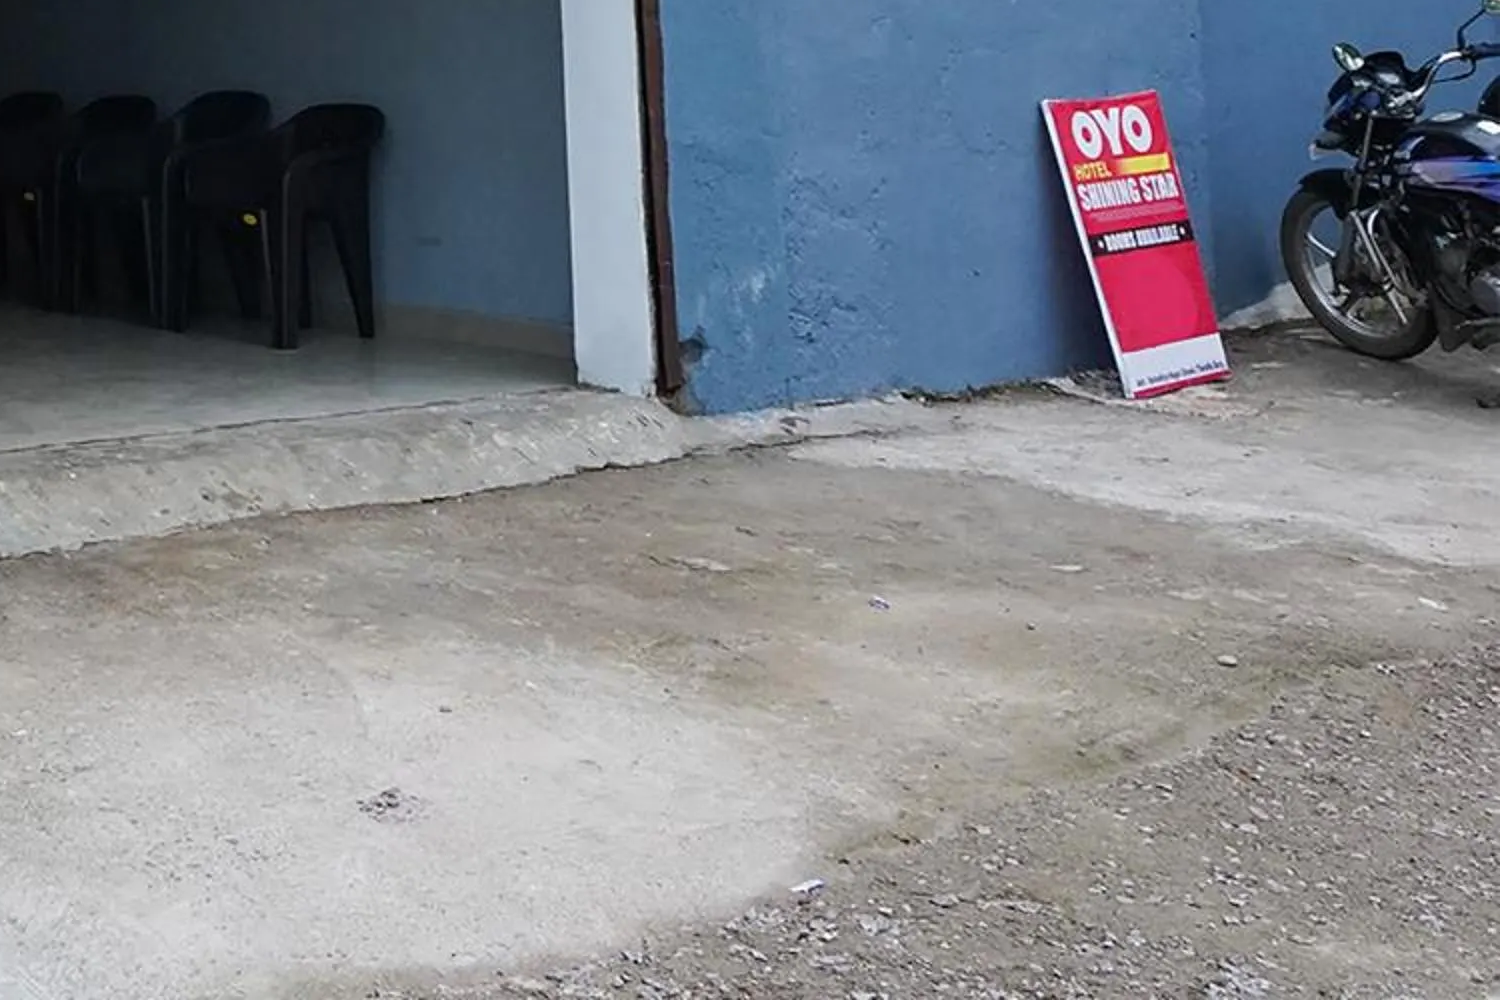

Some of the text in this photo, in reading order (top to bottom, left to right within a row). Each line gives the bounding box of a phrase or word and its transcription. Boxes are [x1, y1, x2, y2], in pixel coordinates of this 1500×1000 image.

[1071, 104, 1153, 160] OYO
[1073, 161, 1112, 181] HOTEL
[1077, 173, 1179, 211] SHINING STAR
